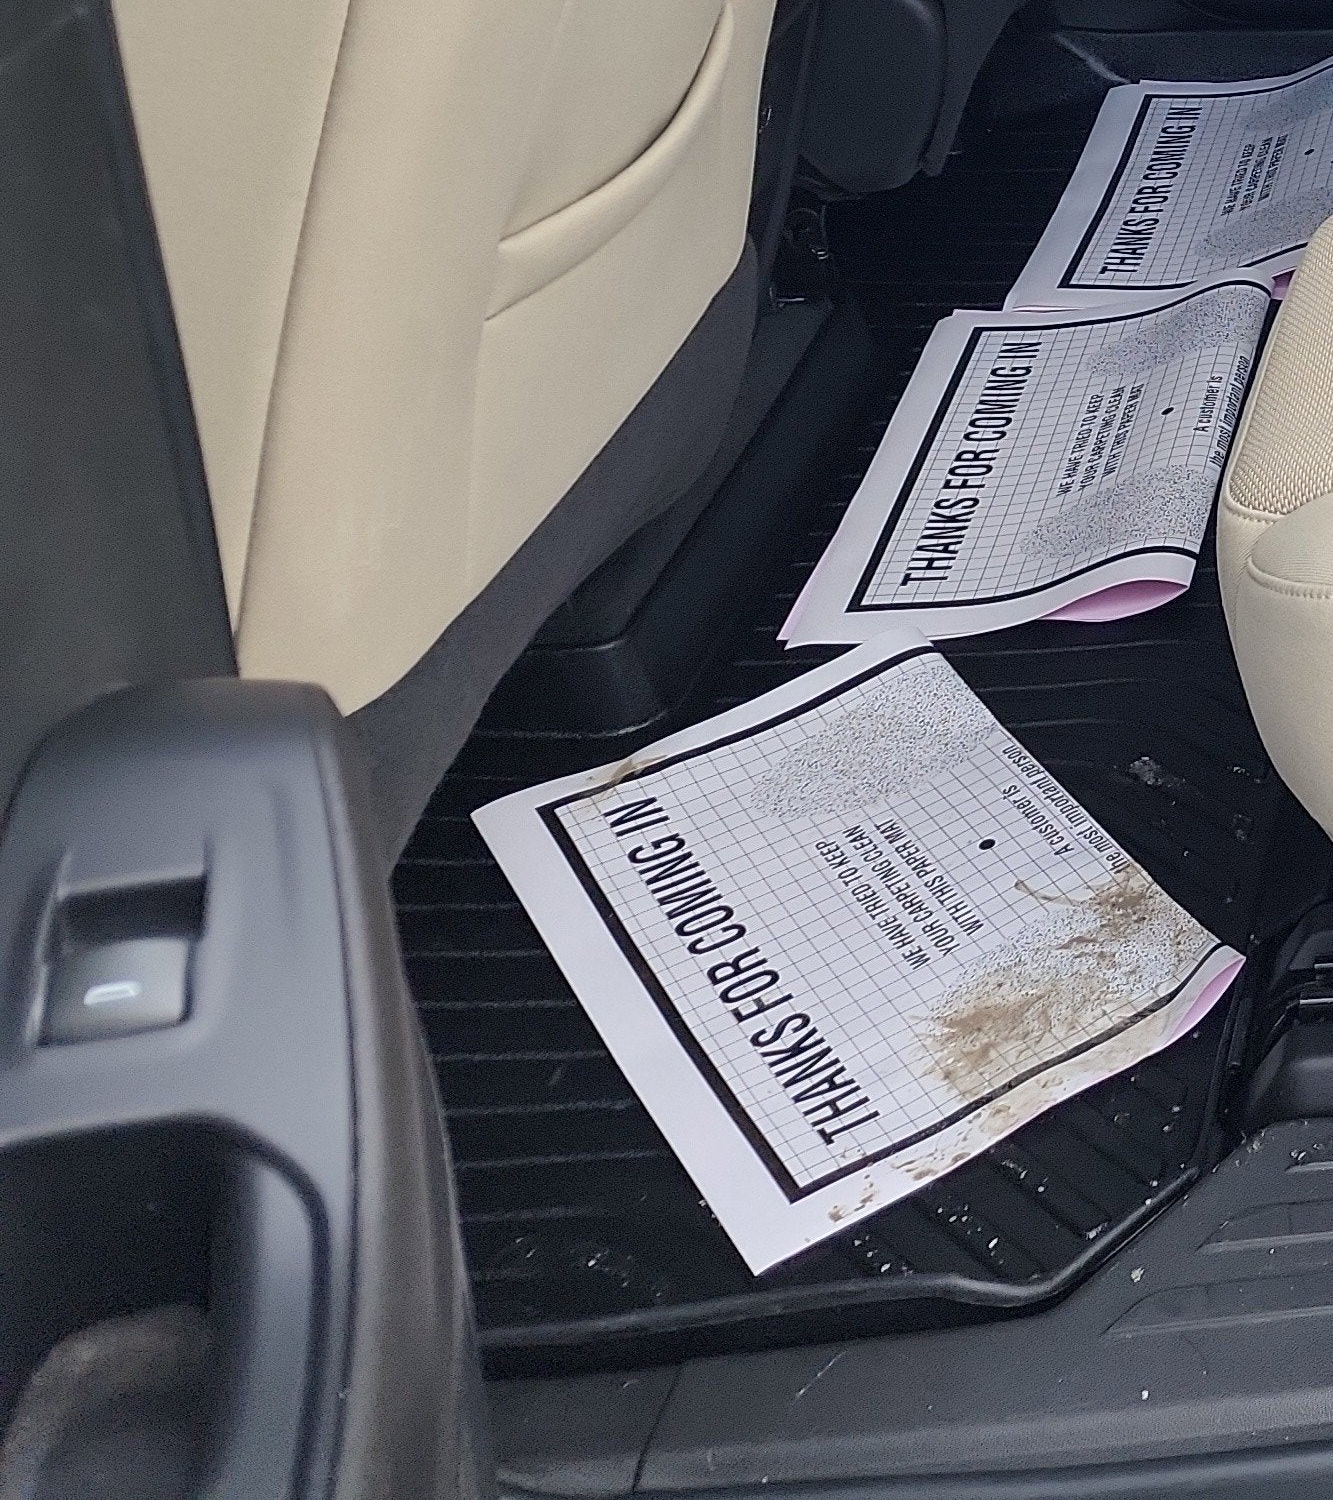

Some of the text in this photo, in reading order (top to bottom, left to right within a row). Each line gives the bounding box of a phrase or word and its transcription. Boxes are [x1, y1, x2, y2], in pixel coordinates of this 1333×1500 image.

[1100, 106, 1202, 274] THANKS FOR COMING IN
[1193, 375, 1223, 433] A customer is
[1219, 383, 1240, 428] important
[1234, 355, 1249, 388] person
[900, 341, 1042, 586] THANKS FOR COMING IN
[1056, 394, 1104, 497] WE HAVE TRIED TO KEEP
[1078, 385, 1126, 491] YOUR CARPETING CLEAN
[1102, 383, 1145, 478] WITH THIS PAPER MAT
[1217, 425, 1231, 451] most
[1002, 745, 1131, 874] the most important person
[1003, 784, 1074, 856] A customer is
[815, 840, 931, 970] WE HAVE TRIED TO KEEP
[842, 825, 961, 957] YOUR CARPETING CLEAN
[874, 818, 984, 936] WITH THIS PAPER MAT
[603, 797, 880, 1145] THANKS FOR COMING IN
